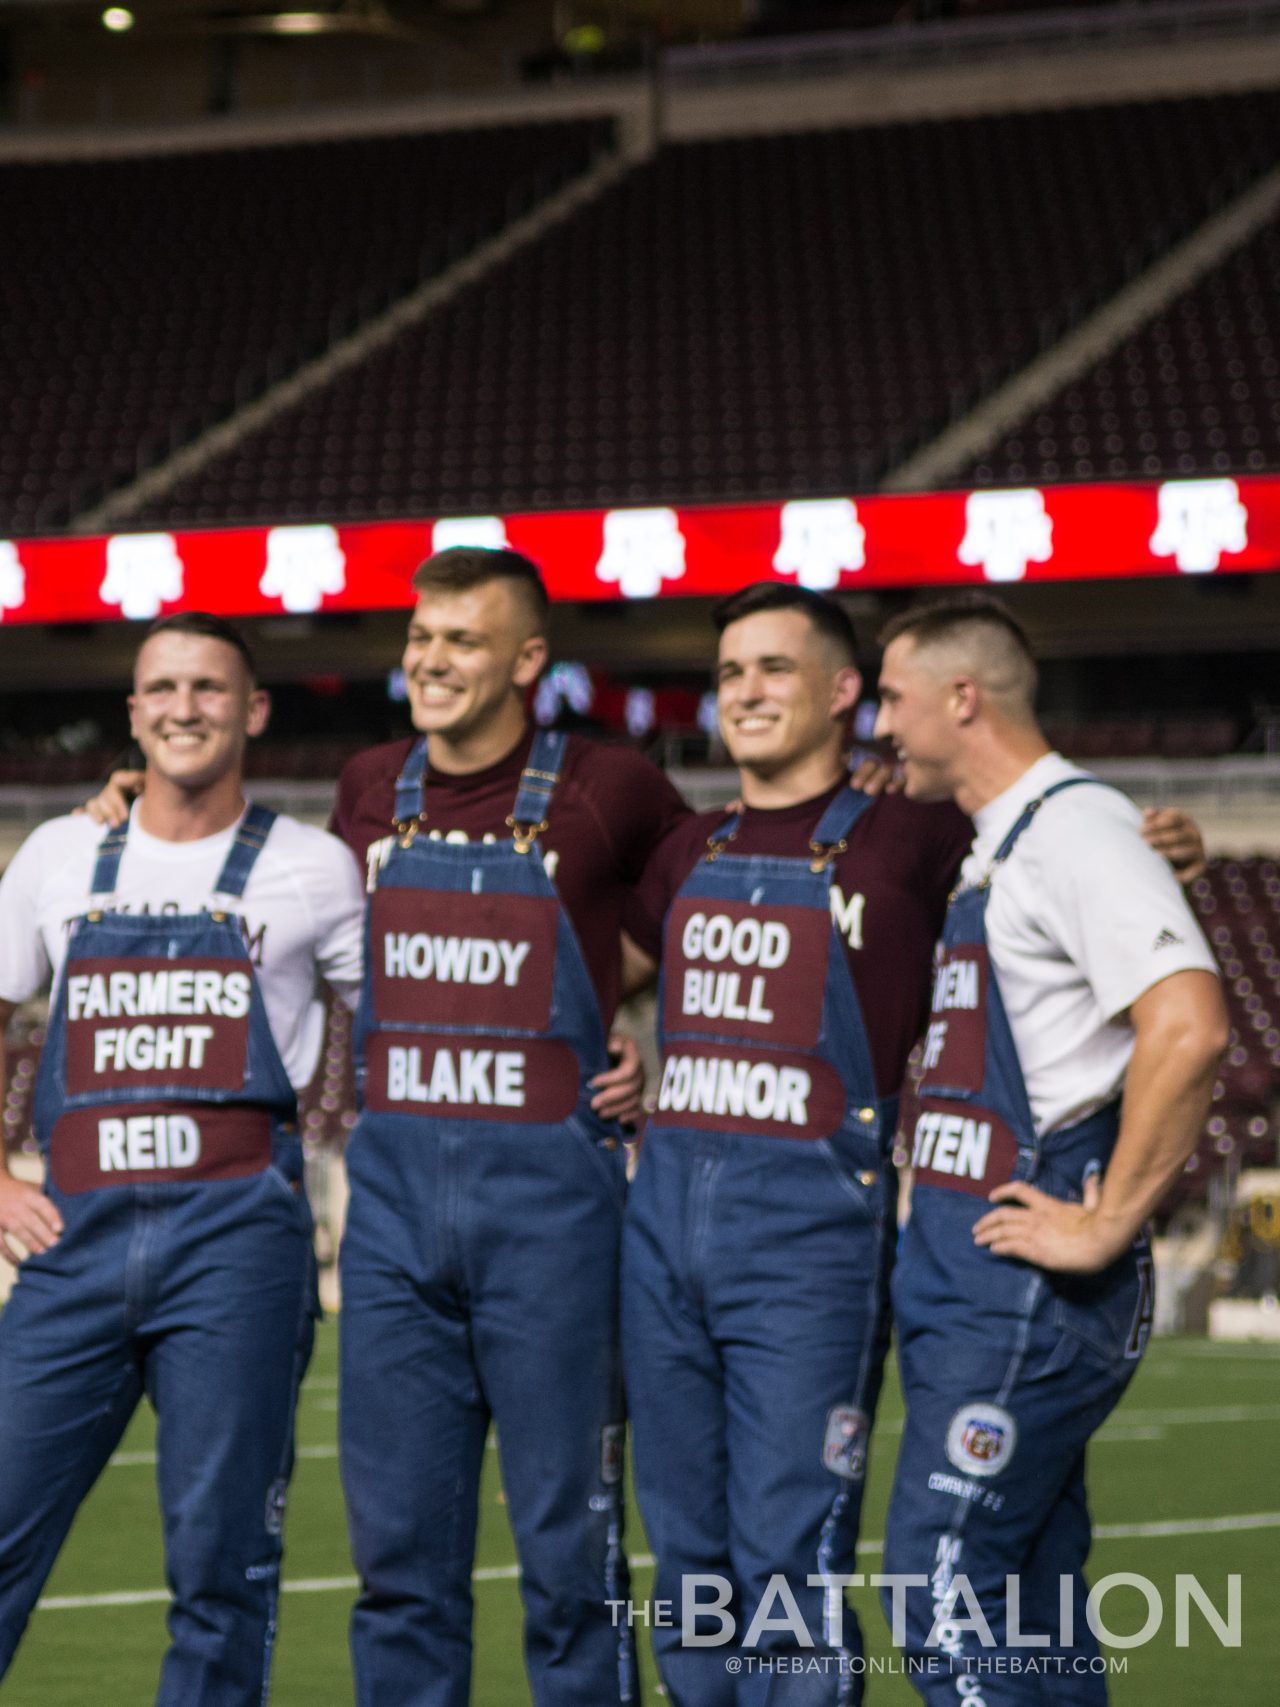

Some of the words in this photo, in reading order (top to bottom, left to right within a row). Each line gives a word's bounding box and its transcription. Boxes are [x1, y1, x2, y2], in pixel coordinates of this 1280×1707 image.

[384, 932, 531, 987] HOWDY
[682, 911, 791, 969] GOOD
[67, 970, 252, 1021] FARMERS
[682, 968, 775, 1024] BULL
[94, 1024, 214, 1074] FIGHT
[386, 1046, 526, 1107] BLAKE
[658, 1055, 812, 1126] CONNOR
[97, 1114, 202, 1172] REID
